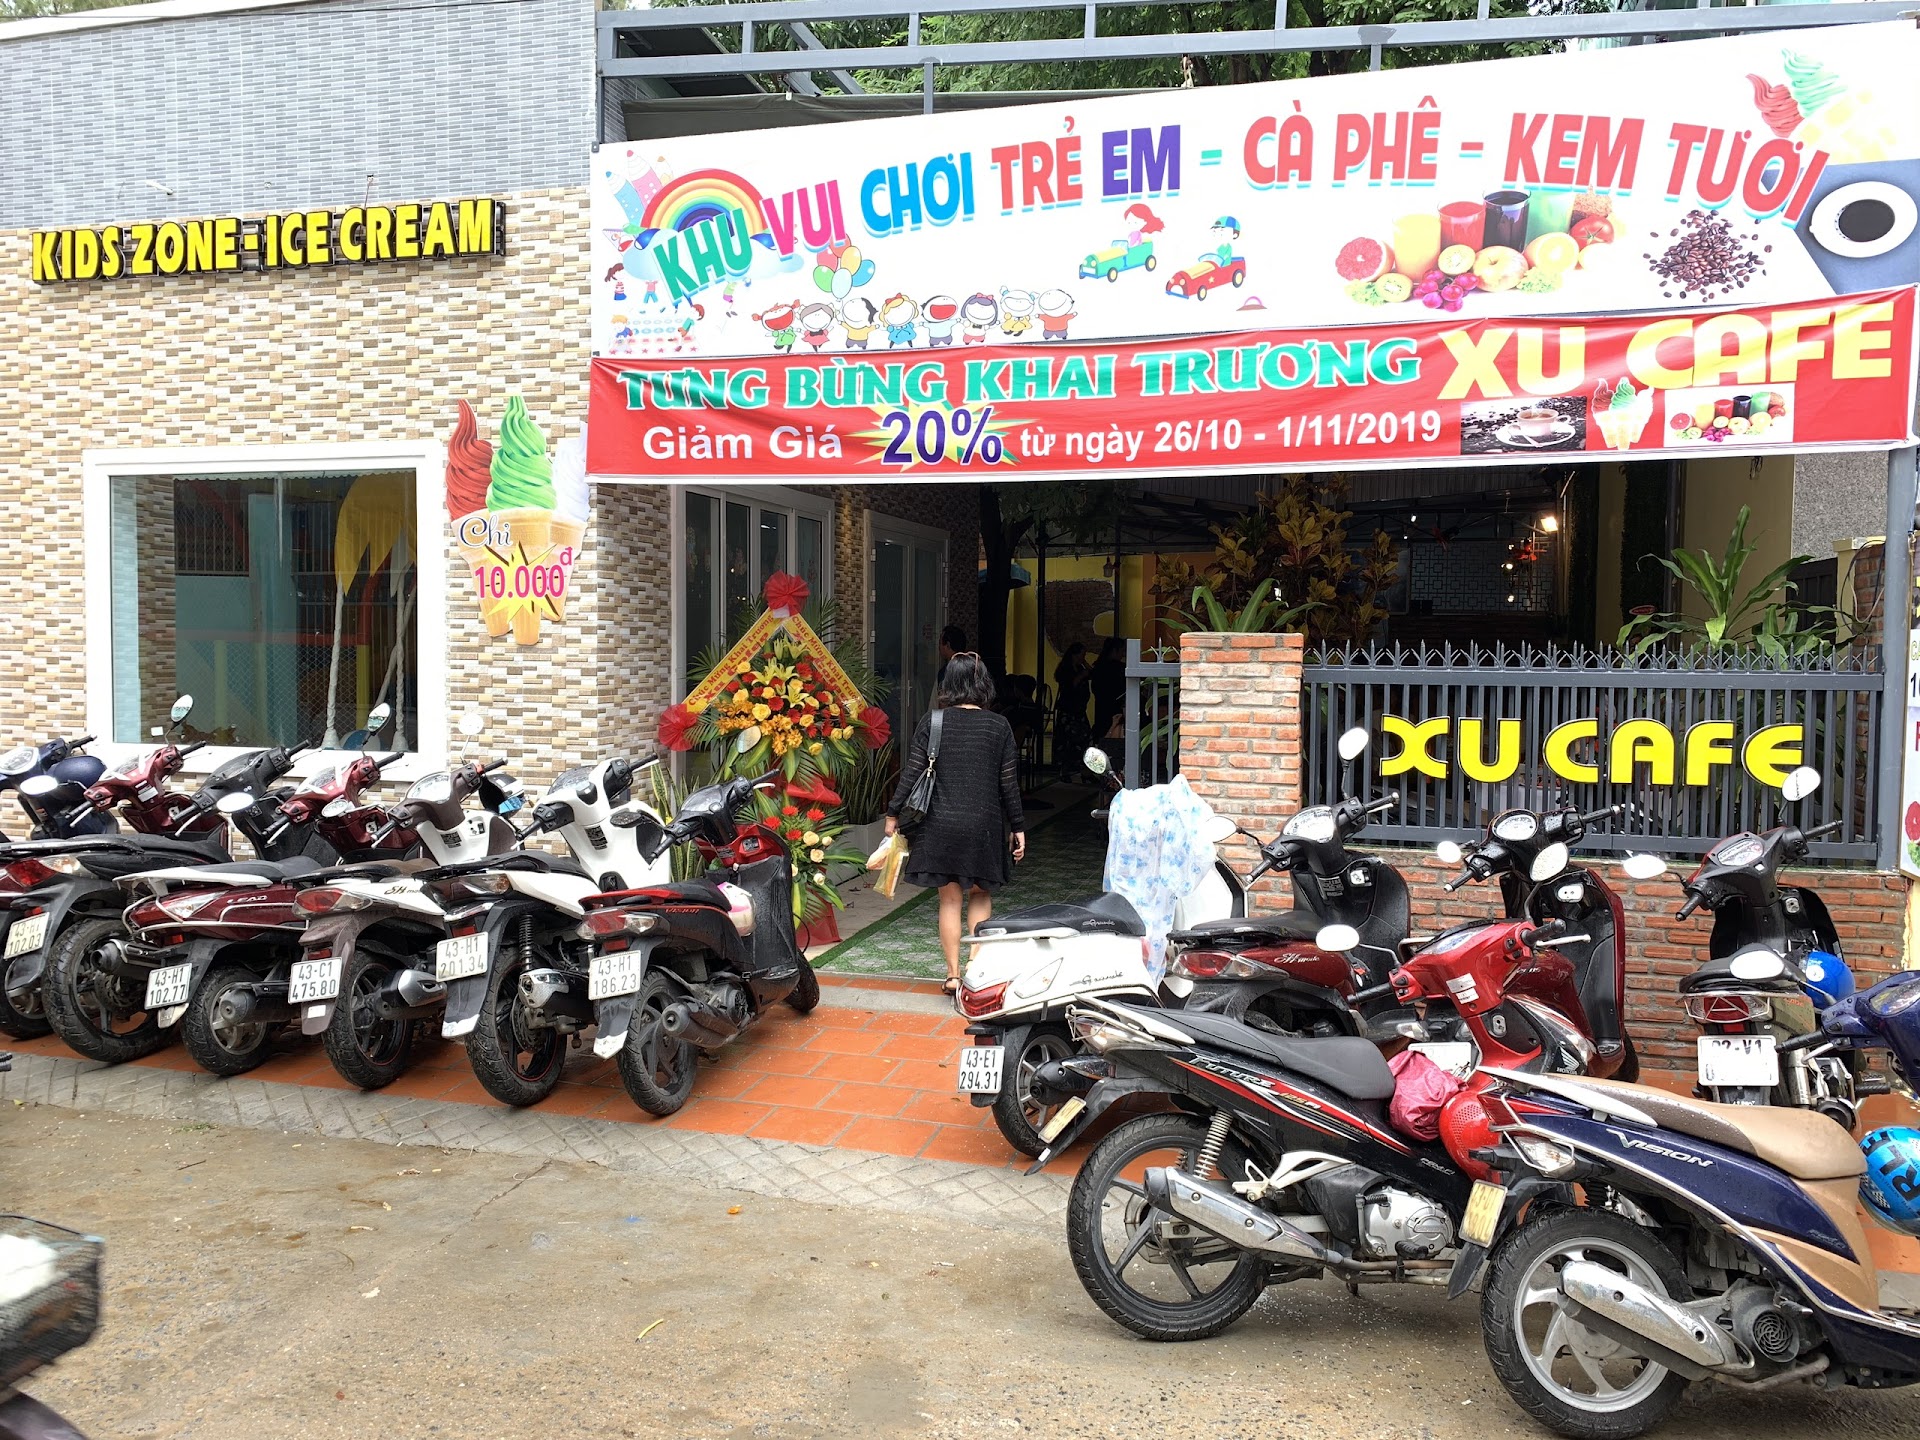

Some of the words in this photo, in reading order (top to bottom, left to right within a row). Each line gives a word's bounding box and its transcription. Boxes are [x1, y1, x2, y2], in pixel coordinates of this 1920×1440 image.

[653, 207, 752, 305] KHU
[761, 179, 847, 260] VUI
[861, 151, 975, 238] CHƠI
[991, 115, 1083, 214] TRẺ
[1101, 124, 1181, 202] EM
[1244, 100, 1313, 190] CÀ
[1332, 95, 1441, 187] PHÊ
[1502, 113, 1645, 196] KEM
[1664, 122, 1830, 227] TƯƠI
[32, 227, 123, 283] KIDS
[339, 198, 496, 263] CREAM
[1436, 326, 1586, 400] XU
[1625, 301, 1895, 390] CAFE
[617, 366, 770, 411] TƯNG
[784, 357, 947, 408] BỪNG
[964, 353, 1118, 401] KHAI
[1130, 337, 1422, 397] TRƯƠNG
[643, 425, 752, 460] Giảm
[769, 423, 843, 460] Giá
[881, 407, 1003, 466] 20%
[1020, 426, 1055, 457] từ
[1065, 423, 1144, 462] ngày
[1154, 418, 1243, 453] 26/10
[1277, 409, 1442, 448] 1/11/2019
[460, 514, 513, 548] Chỉ
[728, 643, 748, 664] Khai
[826, 660, 843, 680] Khai
[1380, 714, 1521, 783] XU
[1543, 717, 1804, 788] CAFE
[227, 895, 268, 905] LEAD
[445, 936, 480, 958] 43-H1
[154, 966, 185, 987] 43-H1
[298, 961, 333, 981] 43-C1
[440, 954, 484, 979] 201.34
[598, 955, 632, 976] 43-H1
[149, 983, 187, 1006] 102.77
[291, 979, 337, 1001] 475.80
[593, 973, 637, 996] 186.23
[966, 1049, 996, 1069] 43-E1
[959, 1070, 999, 1090] 294.31
[1605, 1128, 1716, 1168] VISION
